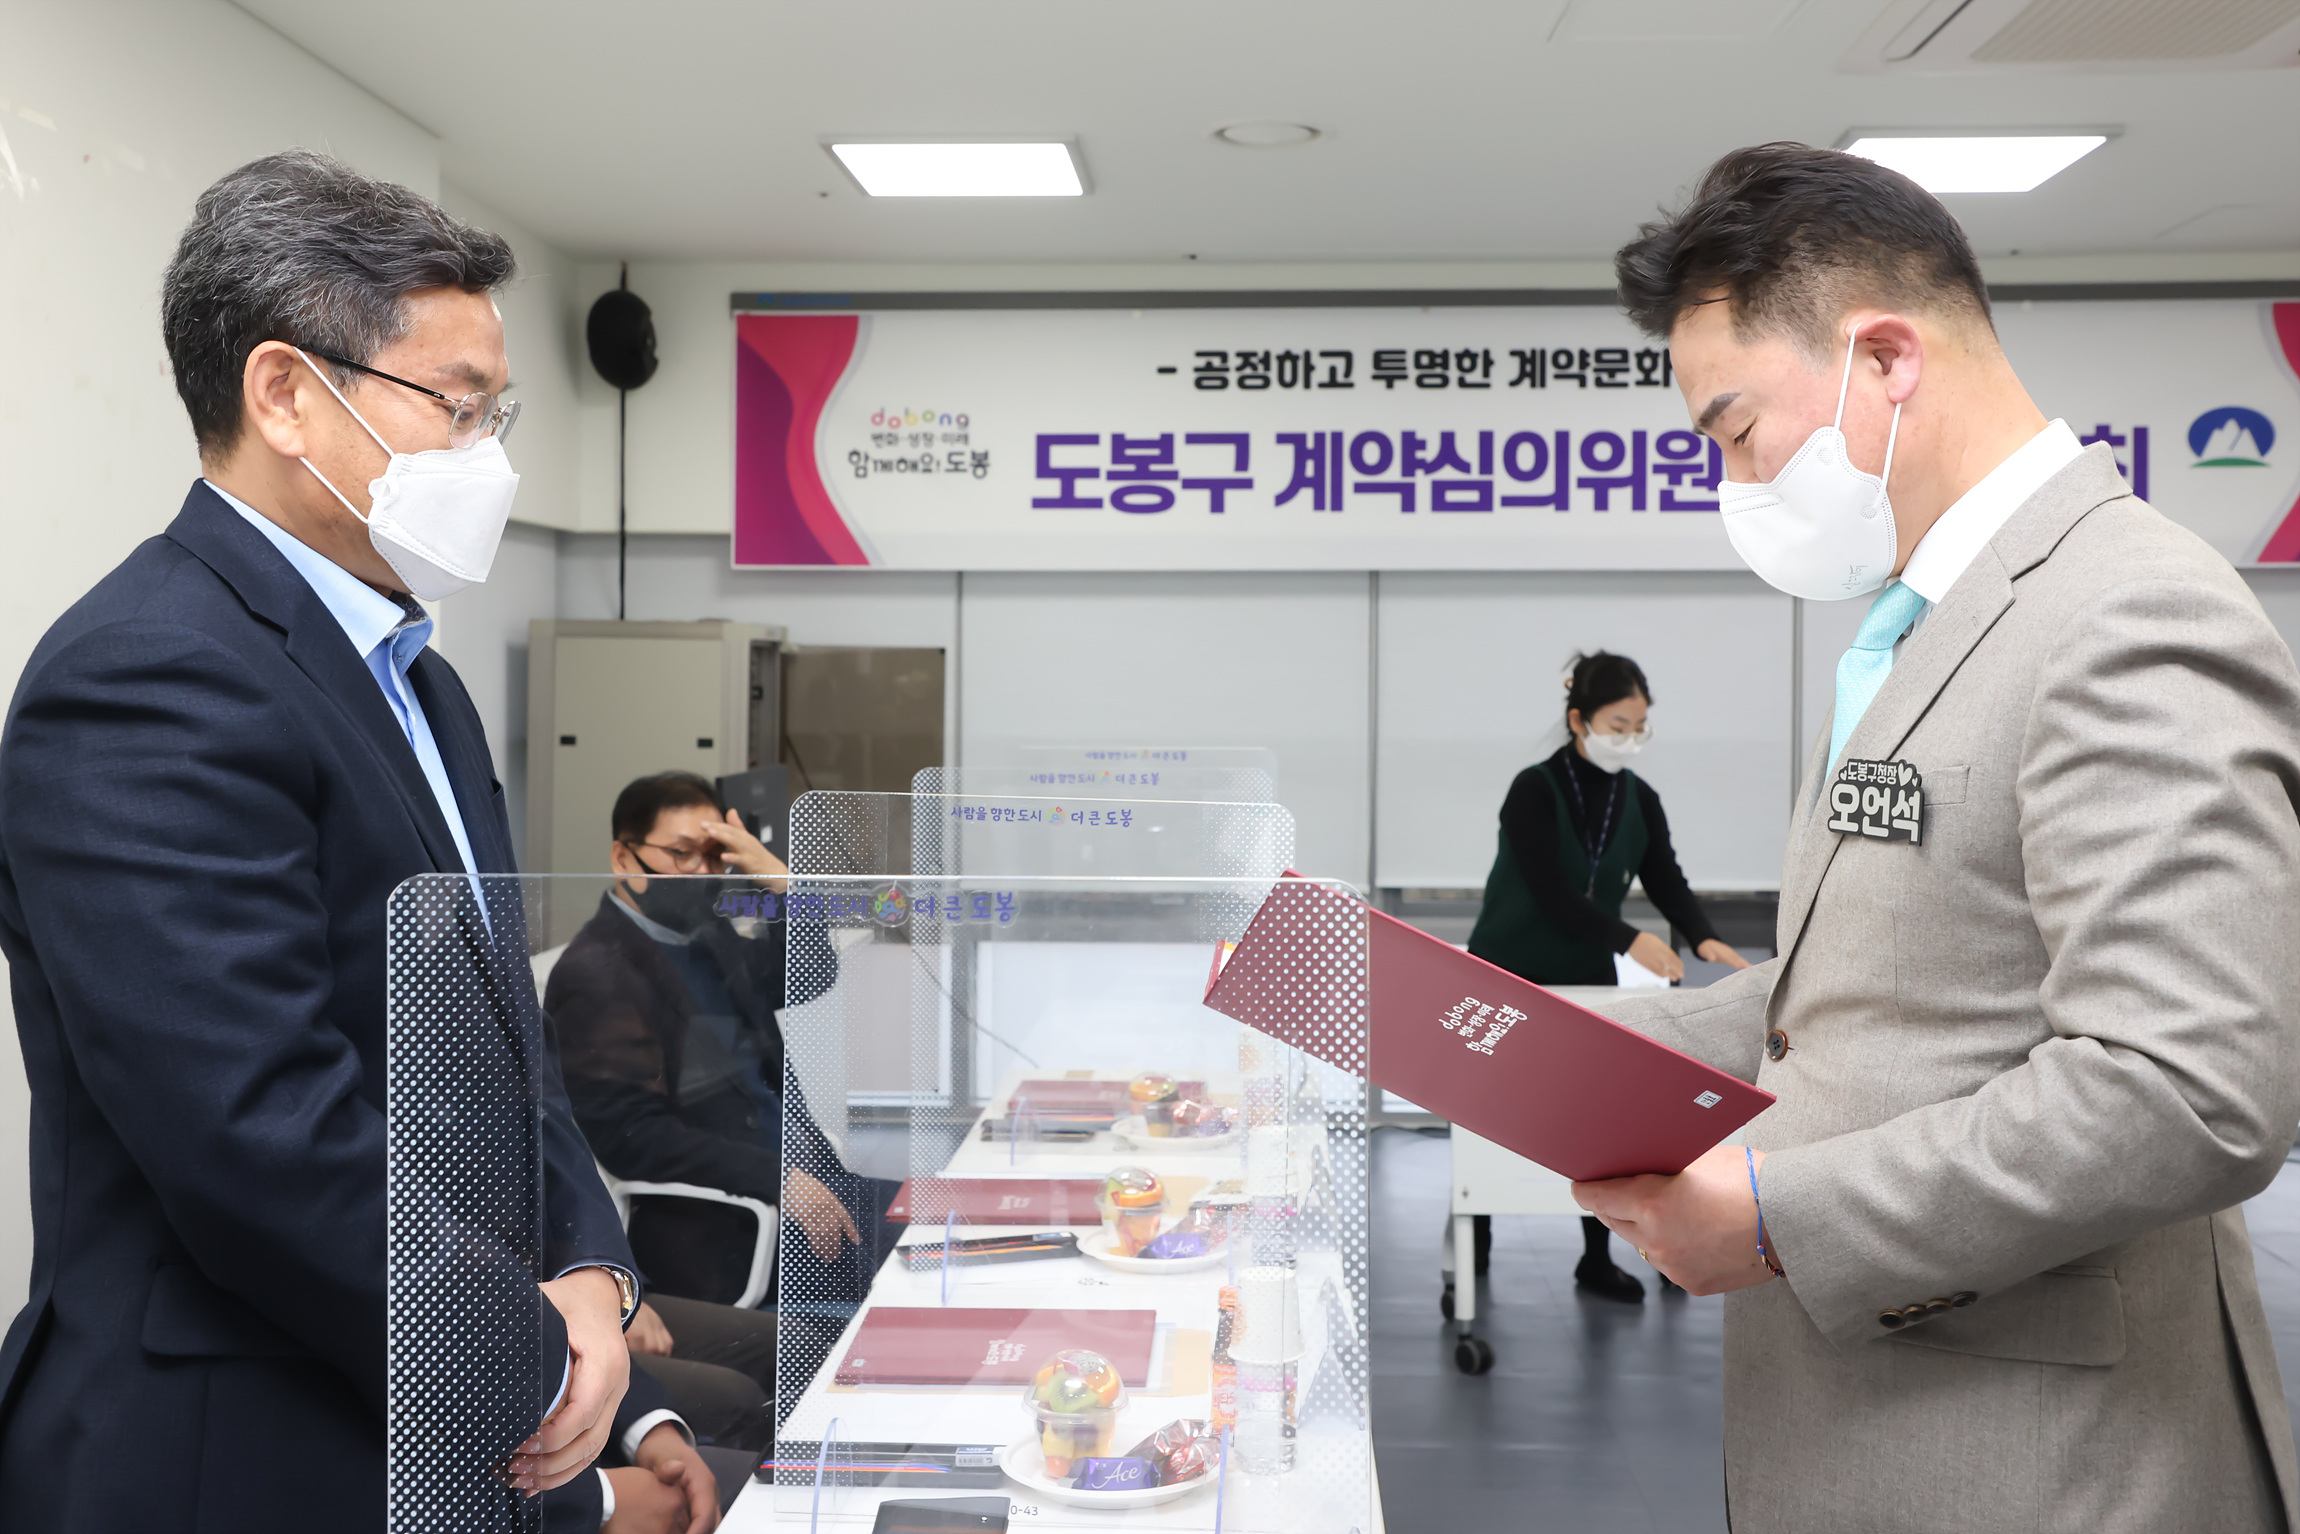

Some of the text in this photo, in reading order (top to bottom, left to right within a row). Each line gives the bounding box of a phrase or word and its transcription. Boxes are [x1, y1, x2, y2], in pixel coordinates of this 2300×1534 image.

[1193, 348, 1355, 390] 공정하고
[1371, 348, 1494, 389] 투명한
[1508, 347, 1673, 389] 계약문화
[870, 406, 970, 430] dobong
[944, 450, 991, 480] 도봉
[1031, 432, 1254, 514] 도봉구
[1140, 772, 1160, 787] 도봉
[1847, 761, 1898, 785] 도봉구청장
[950, 806, 1133, 828] 사람을 향한 도시 더 큰 도봉
[1828, 783, 1921, 842] 오언석
[718, 893, 780, 919] 사람을
[914, 896, 936, 919] 더
[943, 895, 963, 921] 큰
[970, 891, 1016, 923] 도봉
[1438, 996, 1481, 1030] dobong
[1494, 1003, 1528, 1028] 도봉
[1091, 1461, 1142, 1489] Ace
[1010, 1504, 1039, 1516] 0-43
